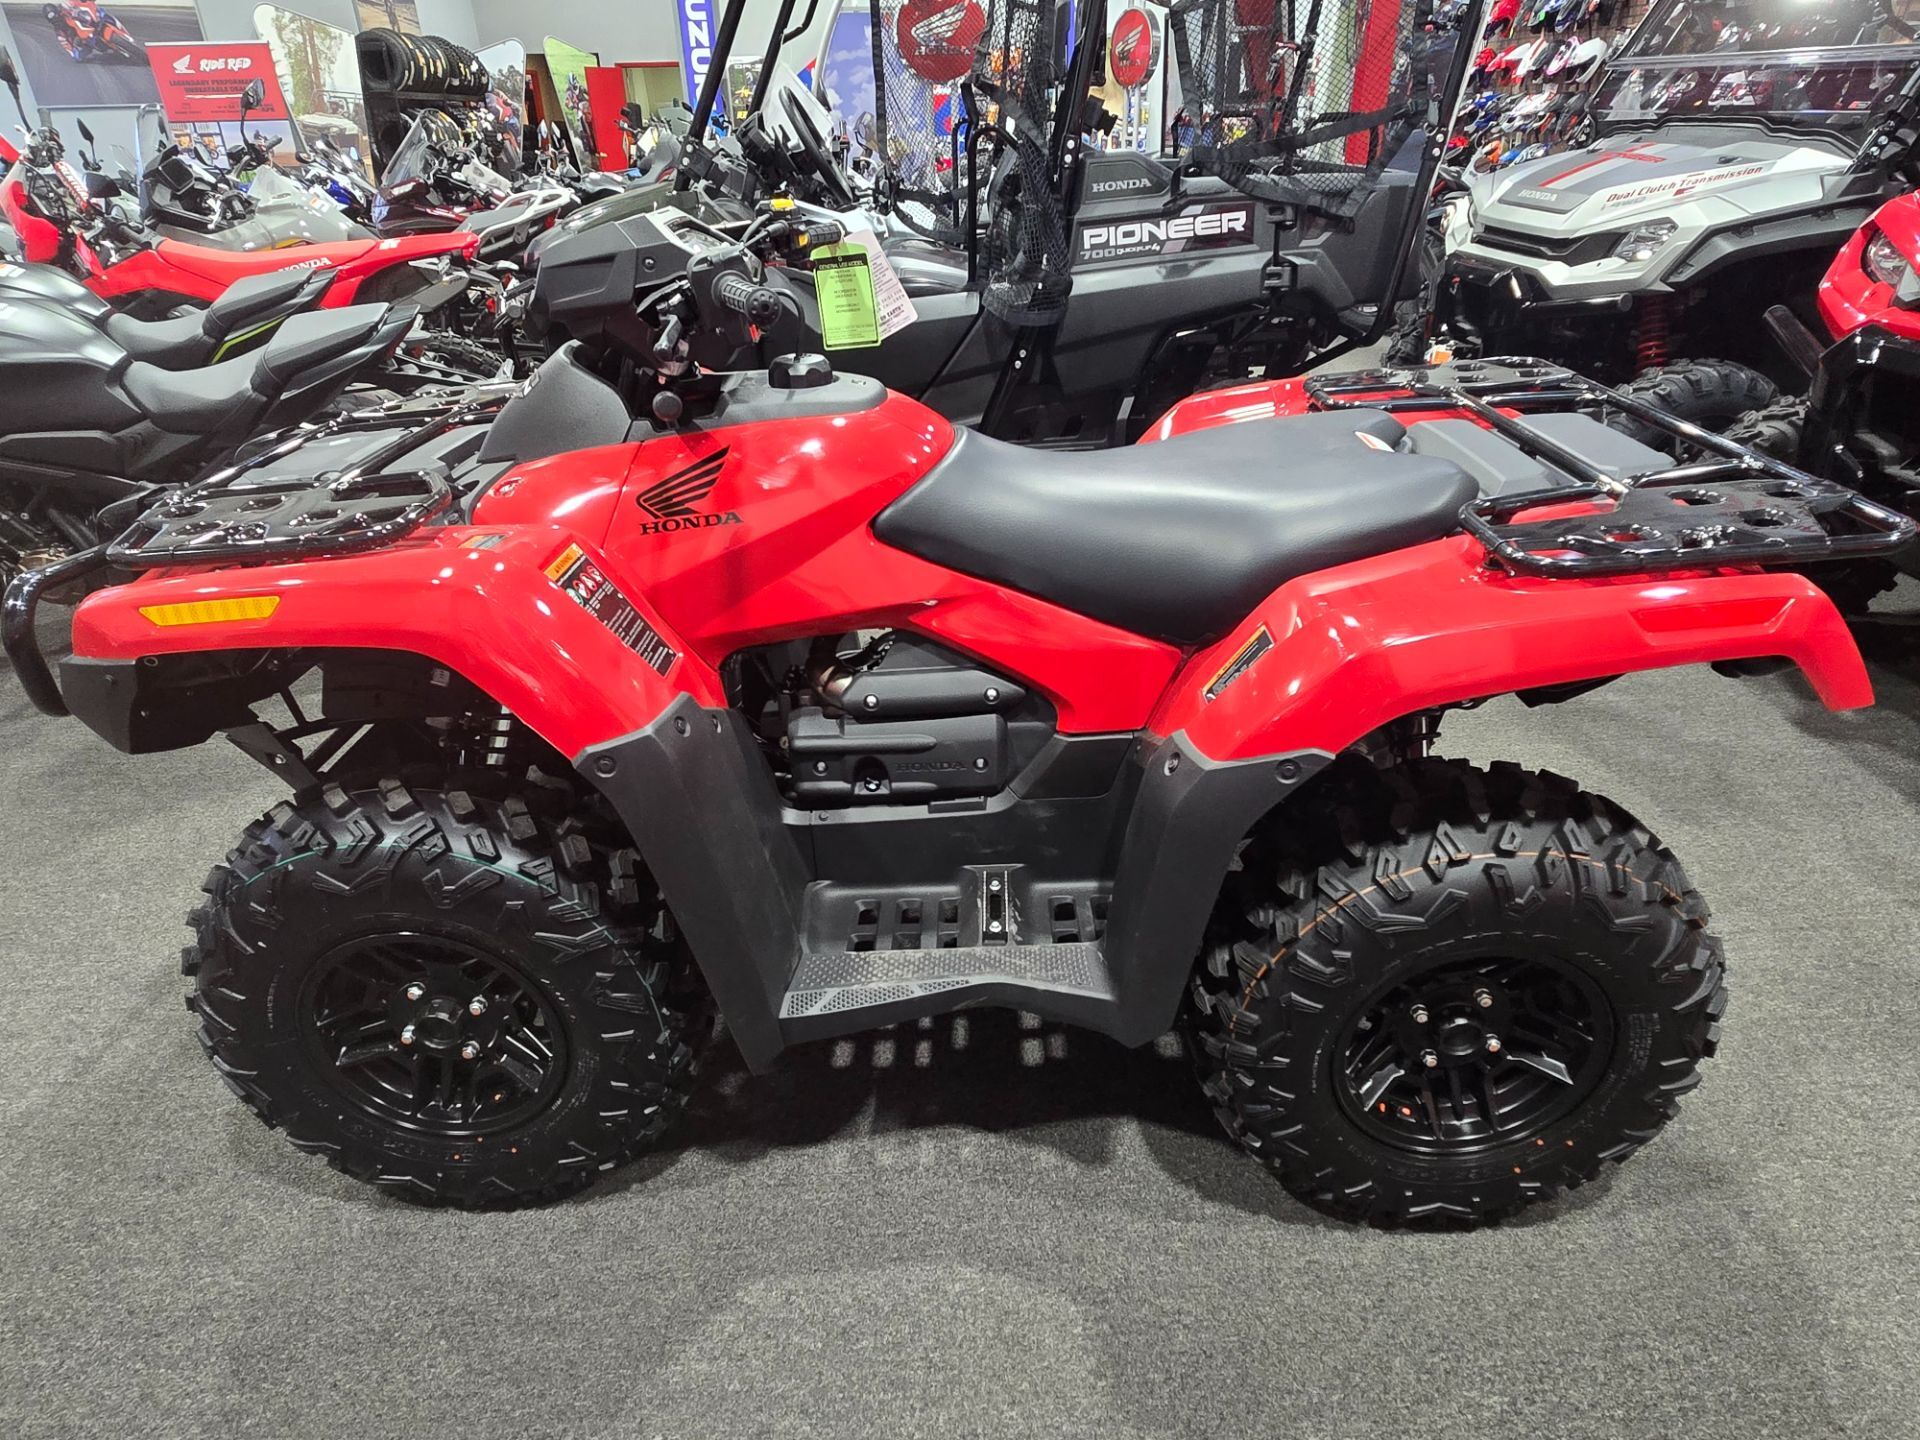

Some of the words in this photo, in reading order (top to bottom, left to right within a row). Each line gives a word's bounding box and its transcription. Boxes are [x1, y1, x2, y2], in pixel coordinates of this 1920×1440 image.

[200, 59, 226, 72] RIDE
[227, 57, 251, 71] RED
[1092, 178, 1152, 193] HONDA
[1606, 188, 1636, 202] Dual
[1638, 181, 1677, 197] Clutch
[1680, 166, 1764, 187] Transmission
[1518, 189, 1558, 201] HONDA
[1083, 210, 1248, 250] PIONEER
[1080, 248, 1116, 260] 700
[640, 511, 744, 535] HONDA
[895, 761, 967, 773] HONDA
